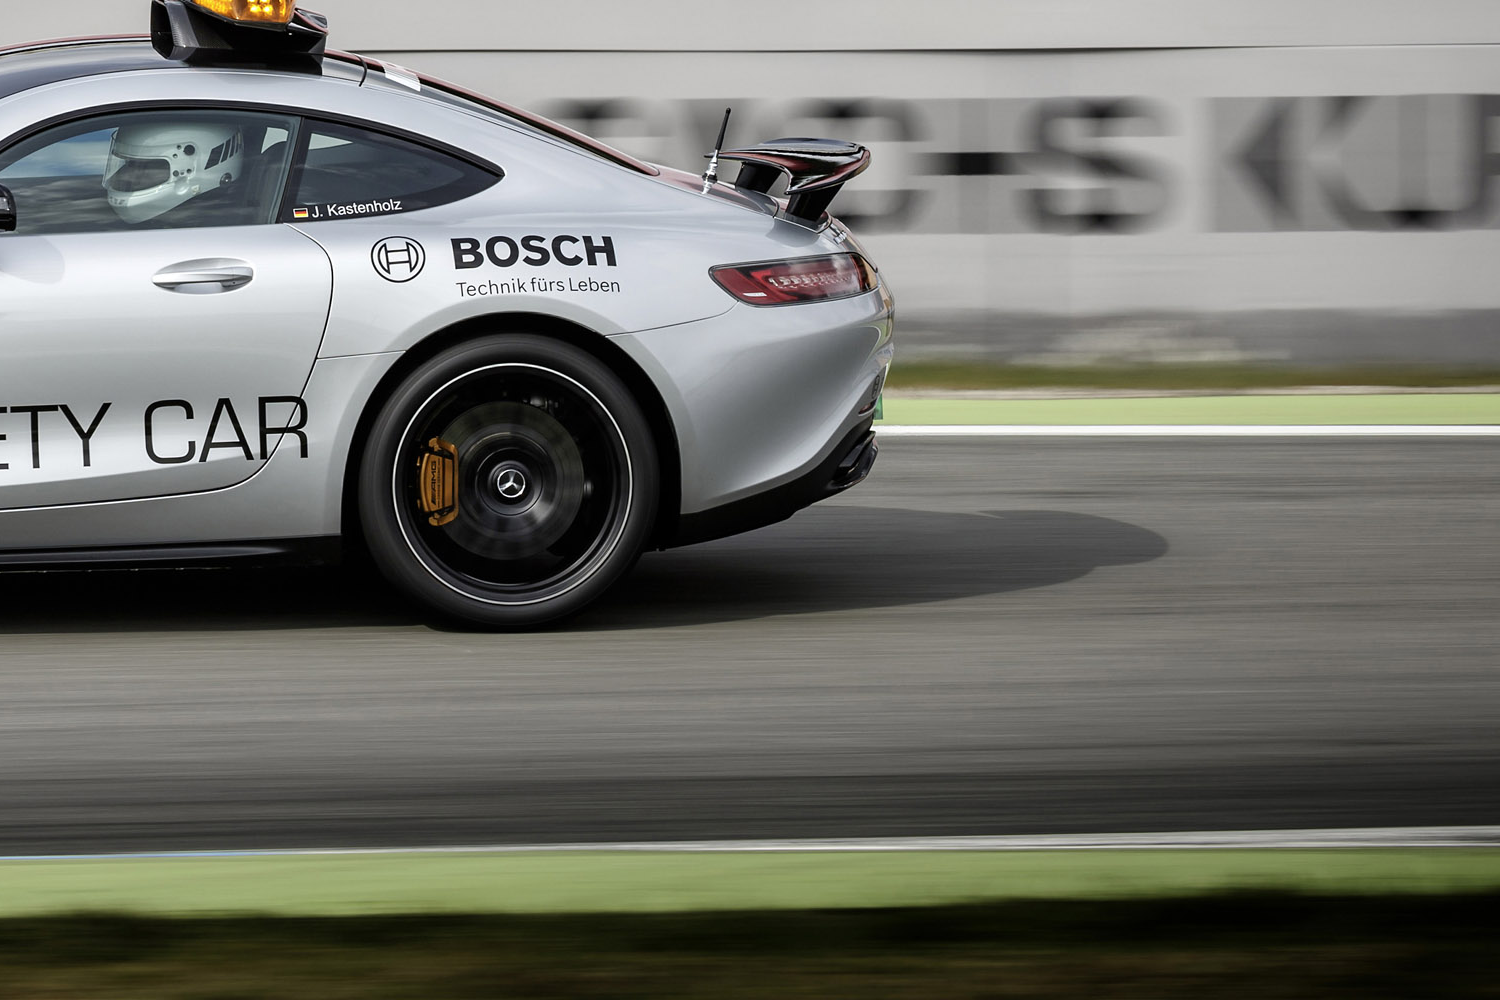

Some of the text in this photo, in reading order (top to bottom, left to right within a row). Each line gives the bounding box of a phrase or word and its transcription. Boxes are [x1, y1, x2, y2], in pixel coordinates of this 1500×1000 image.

[311, 199, 402, 218] J. Kastenholz
[450, 235, 618, 270] BOSCH
[456, 277, 621, 297] Technik fürs Leben
[145, 395, 309, 465] CAR
